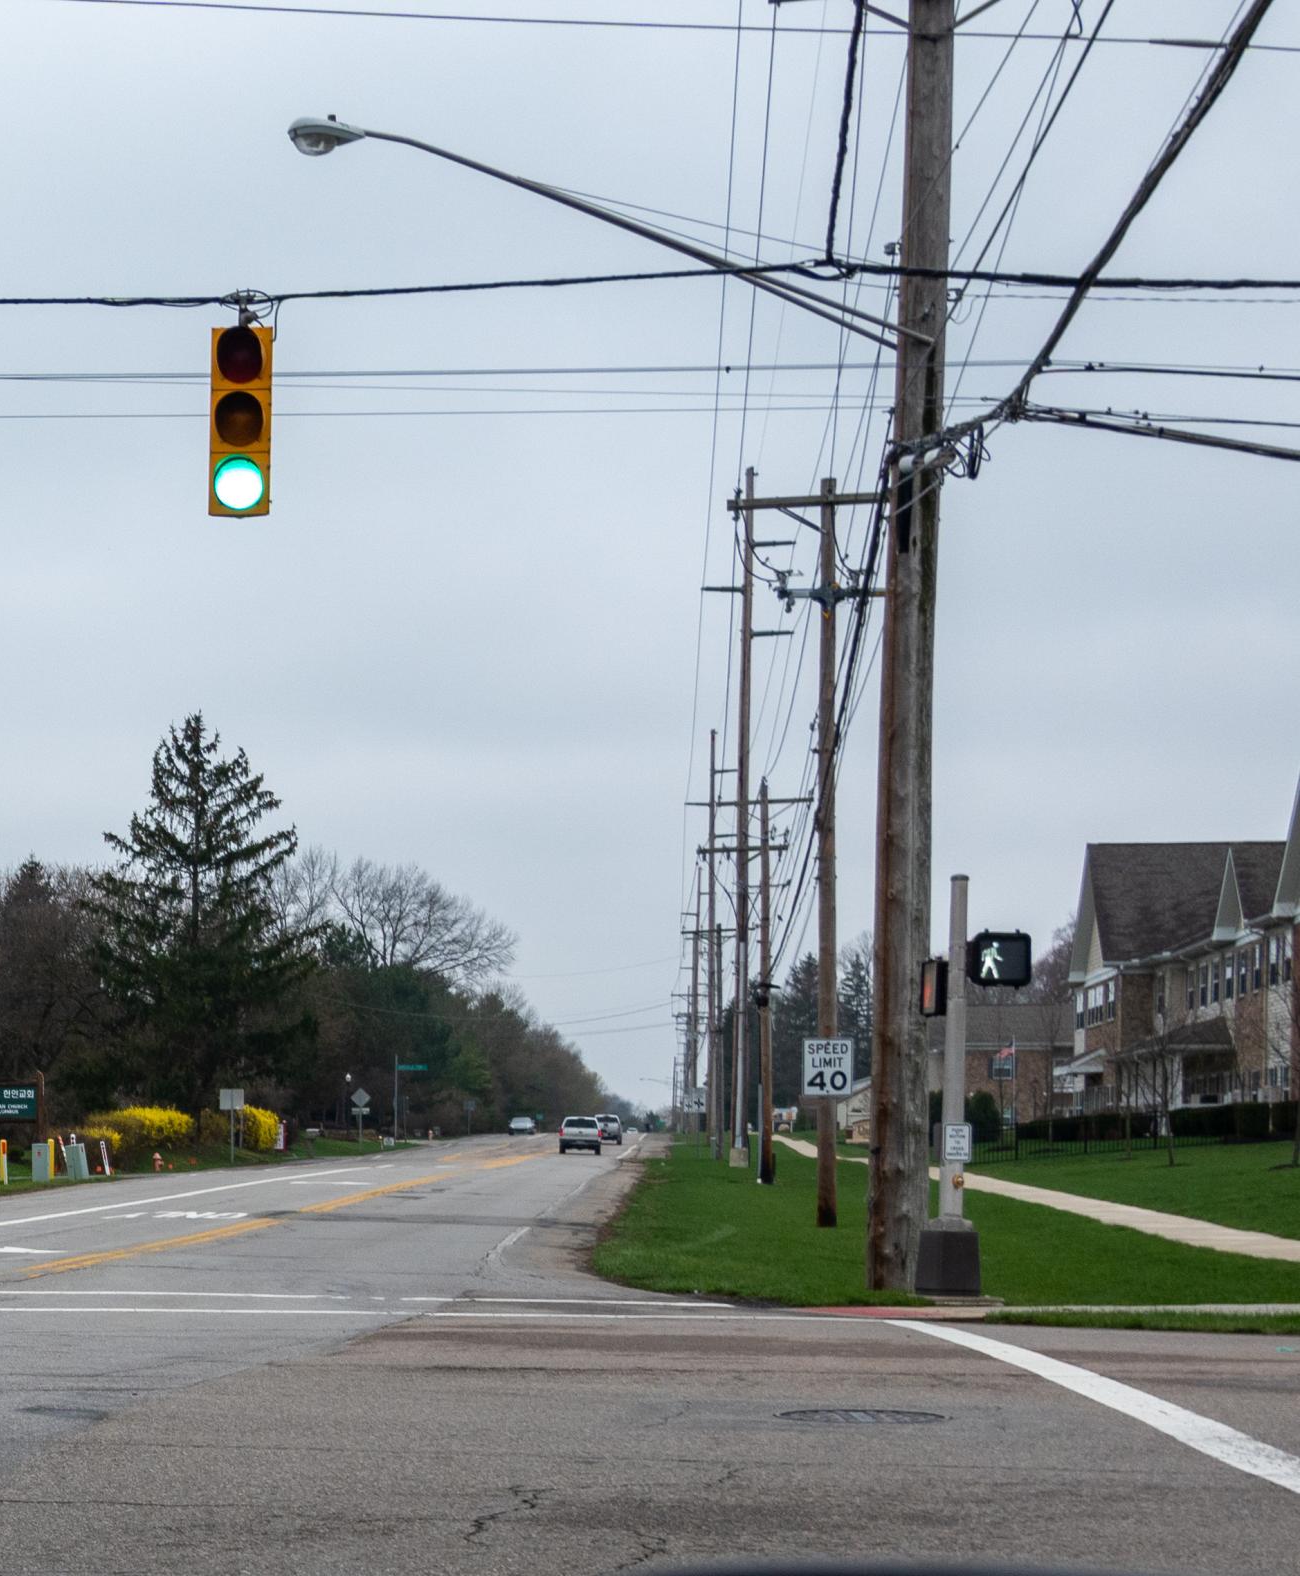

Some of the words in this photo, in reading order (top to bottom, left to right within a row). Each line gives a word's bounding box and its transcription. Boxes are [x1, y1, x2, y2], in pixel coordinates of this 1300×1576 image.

[807, 1043, 849, 1055] SPEED
[811, 1057, 844, 1069] LIMIT
[807, 1071, 847, 1091] 40
